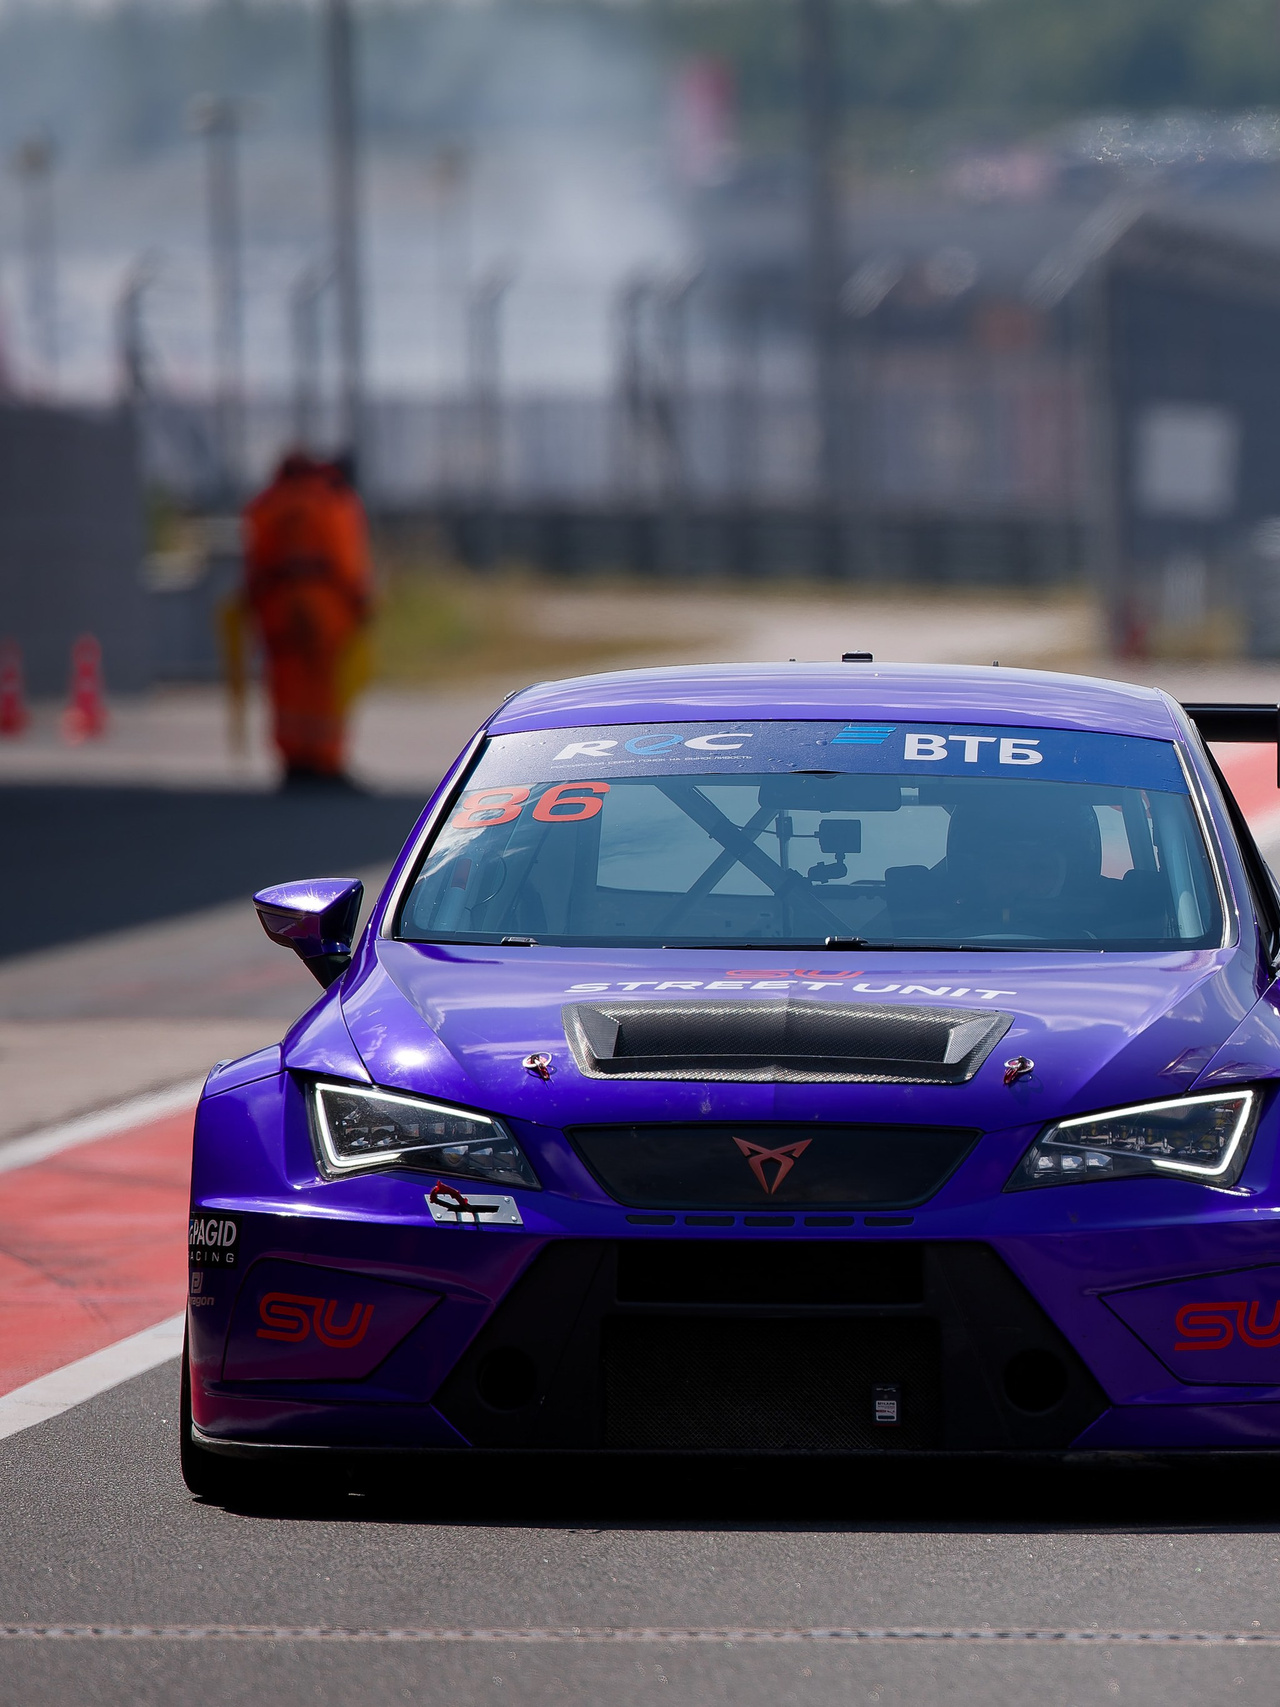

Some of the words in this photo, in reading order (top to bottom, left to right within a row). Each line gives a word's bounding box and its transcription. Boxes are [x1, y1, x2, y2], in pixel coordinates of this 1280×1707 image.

[903, 733, 1043, 765] ВТБ
[452, 781, 611, 830] 86
[564, 980, 844, 993] STREET
[852, 983, 1018, 1000] UNIT
[192, 1219, 237, 1247] PAGID
[256, 1292, 375, 1348] SU
